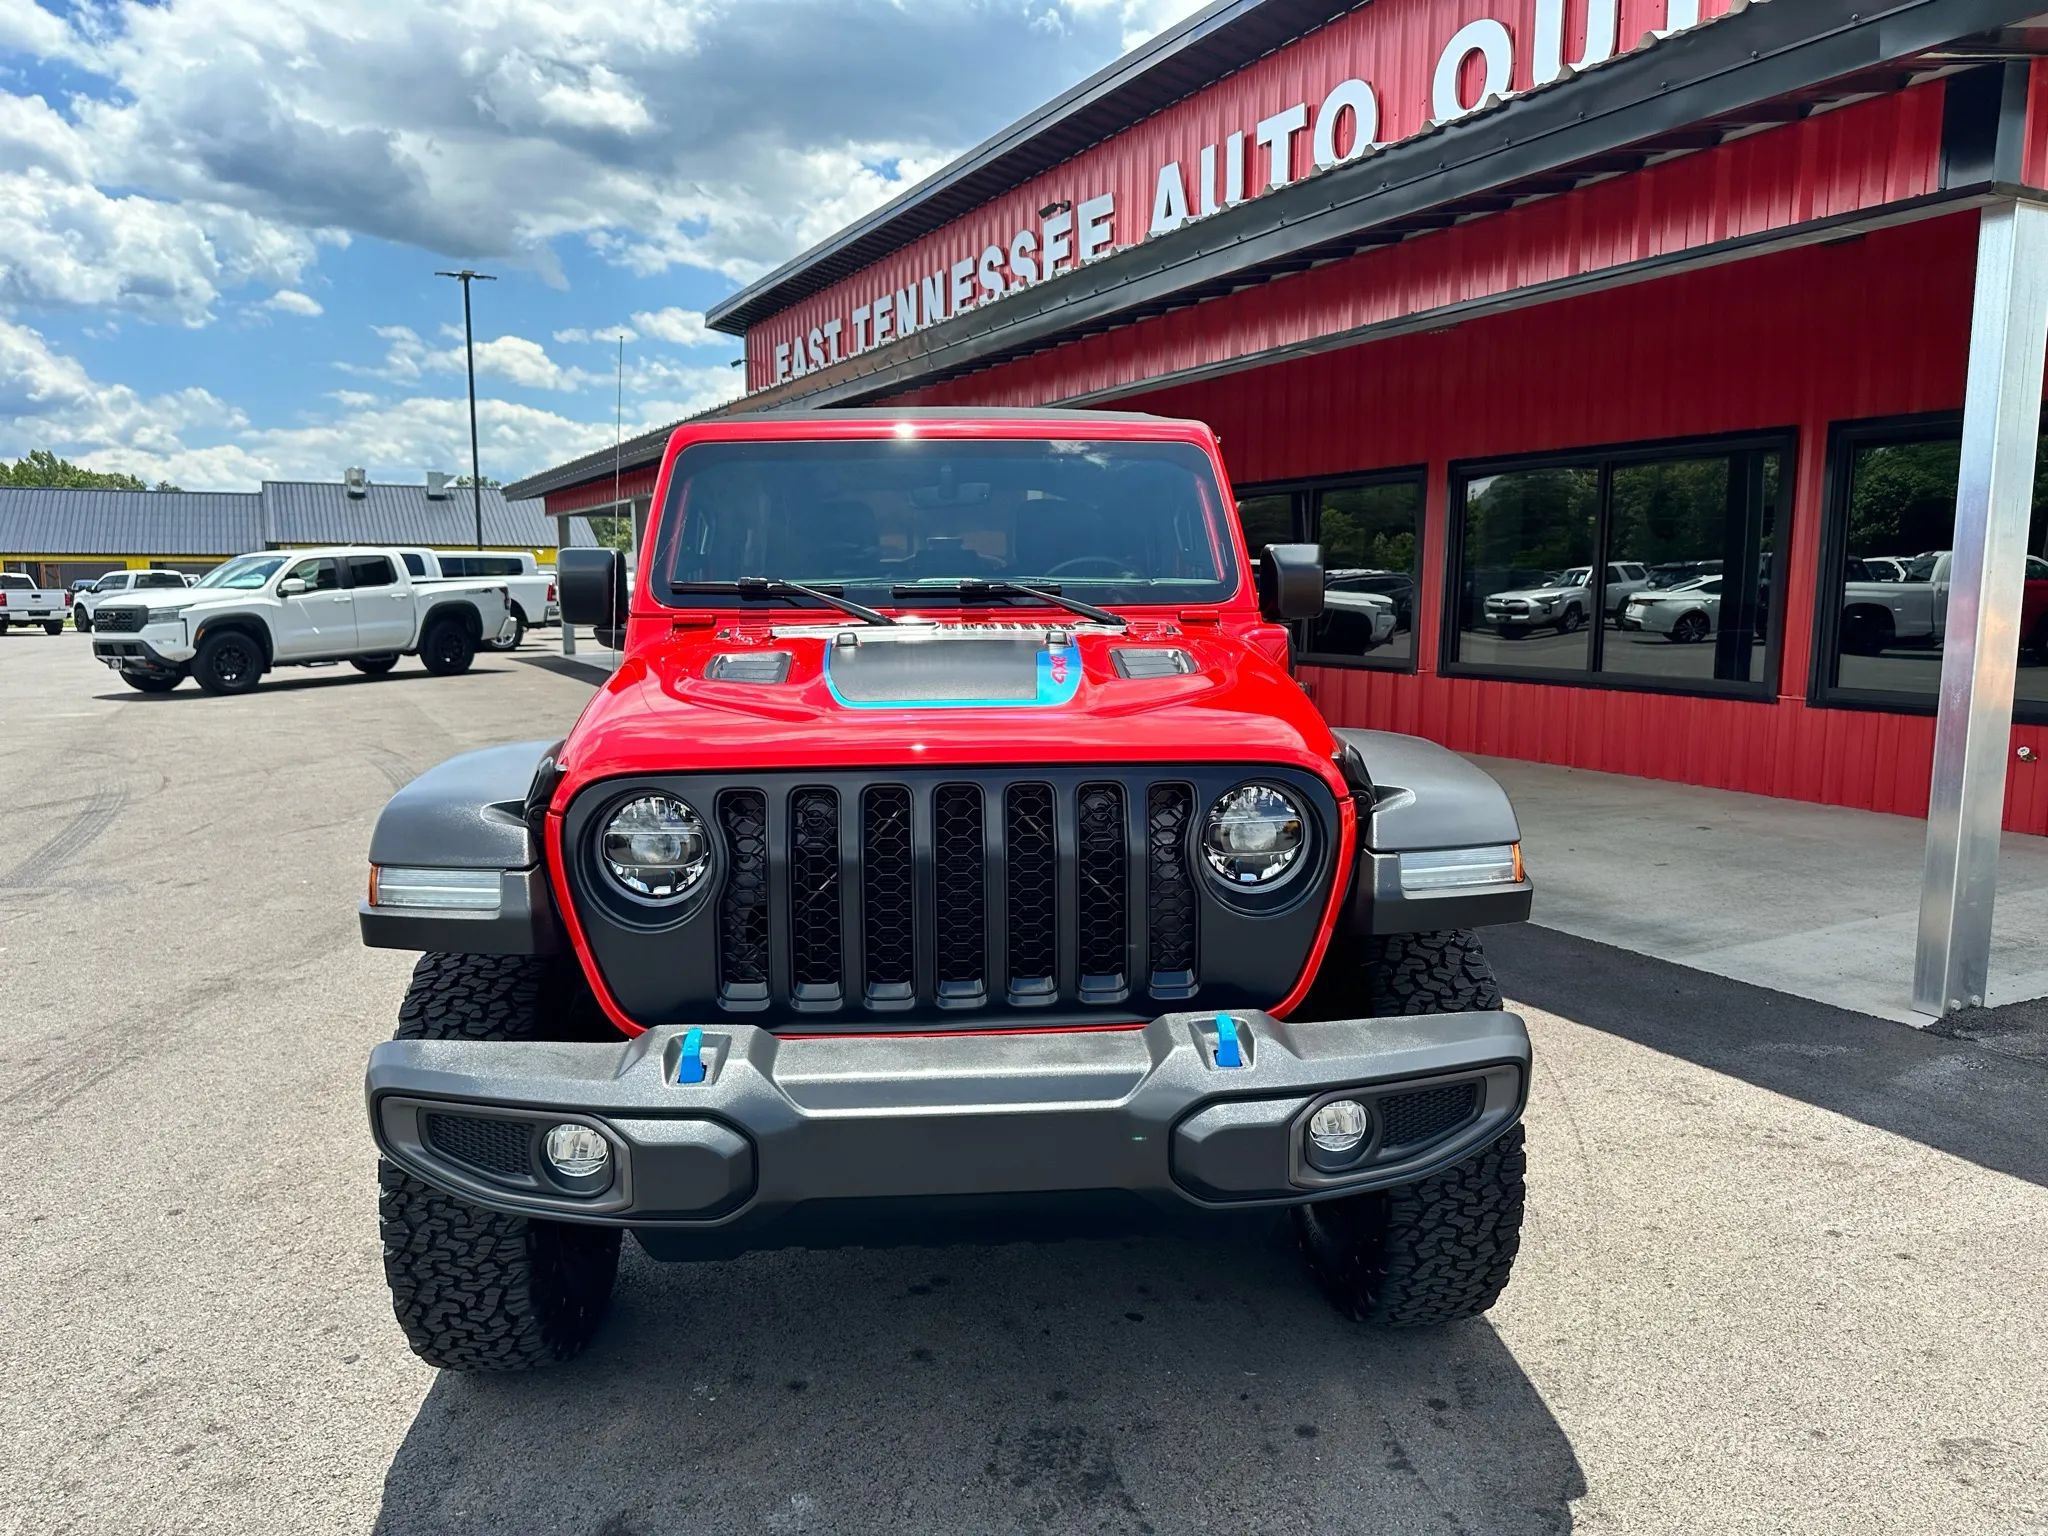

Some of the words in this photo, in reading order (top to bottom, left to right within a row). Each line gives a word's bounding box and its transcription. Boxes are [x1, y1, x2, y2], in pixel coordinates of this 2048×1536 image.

[776, 318, 842, 384] EAST
[852, 192, 1114, 354] TENNESSEE
[1150, 79, 1378, 236] AUTO
